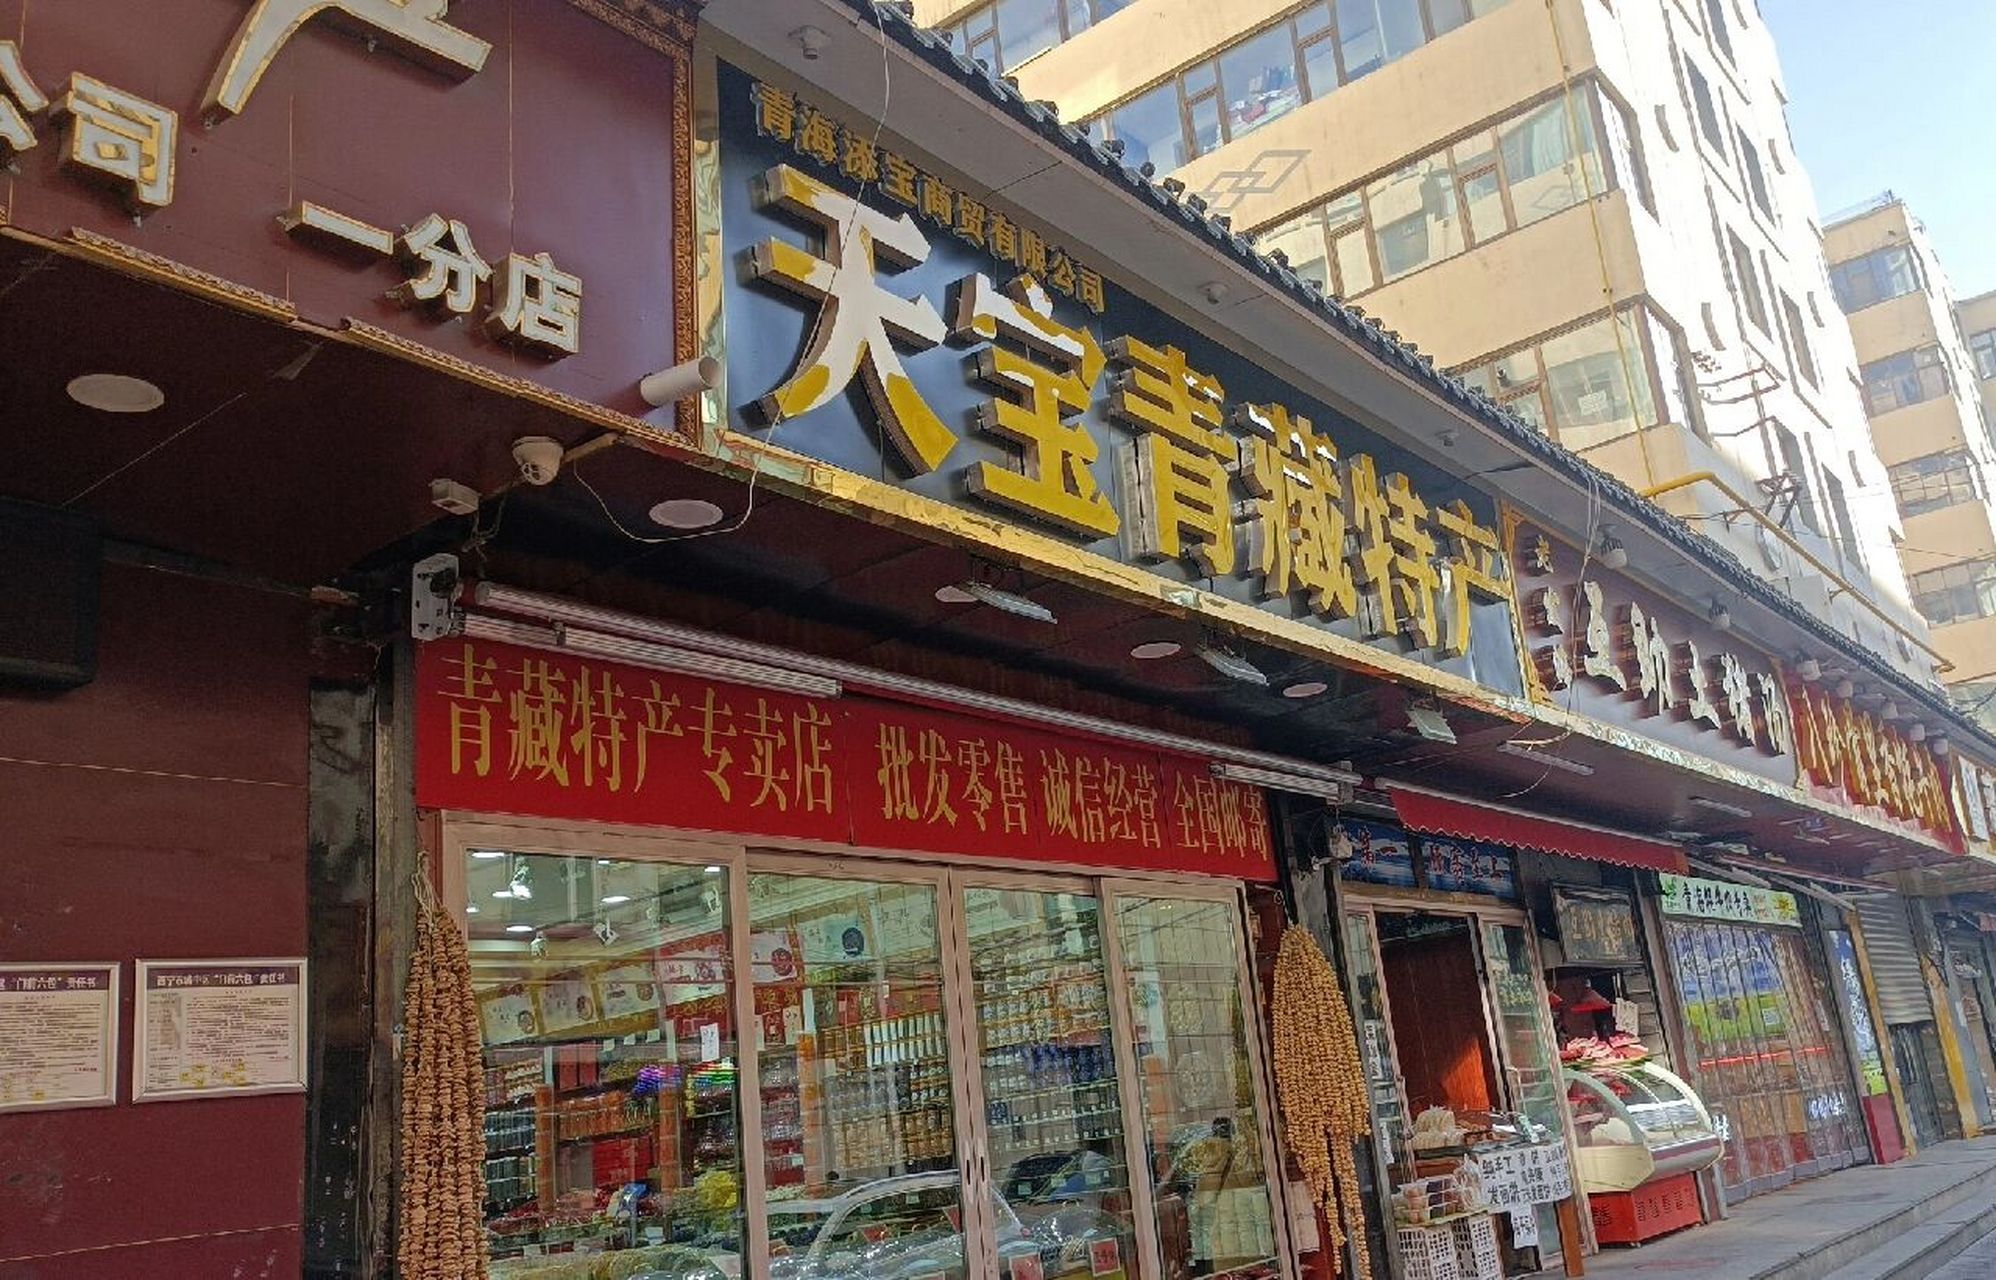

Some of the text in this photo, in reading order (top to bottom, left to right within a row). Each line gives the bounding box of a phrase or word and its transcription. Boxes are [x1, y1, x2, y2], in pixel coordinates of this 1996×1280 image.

[300, 200, 582, 355] 一分店
[754, 164, 1512, 658] 天宝青藏特产
[438, 644, 1267, 861] 青藏特产专卖店 批发零售 诚信经营 全国邮寄
